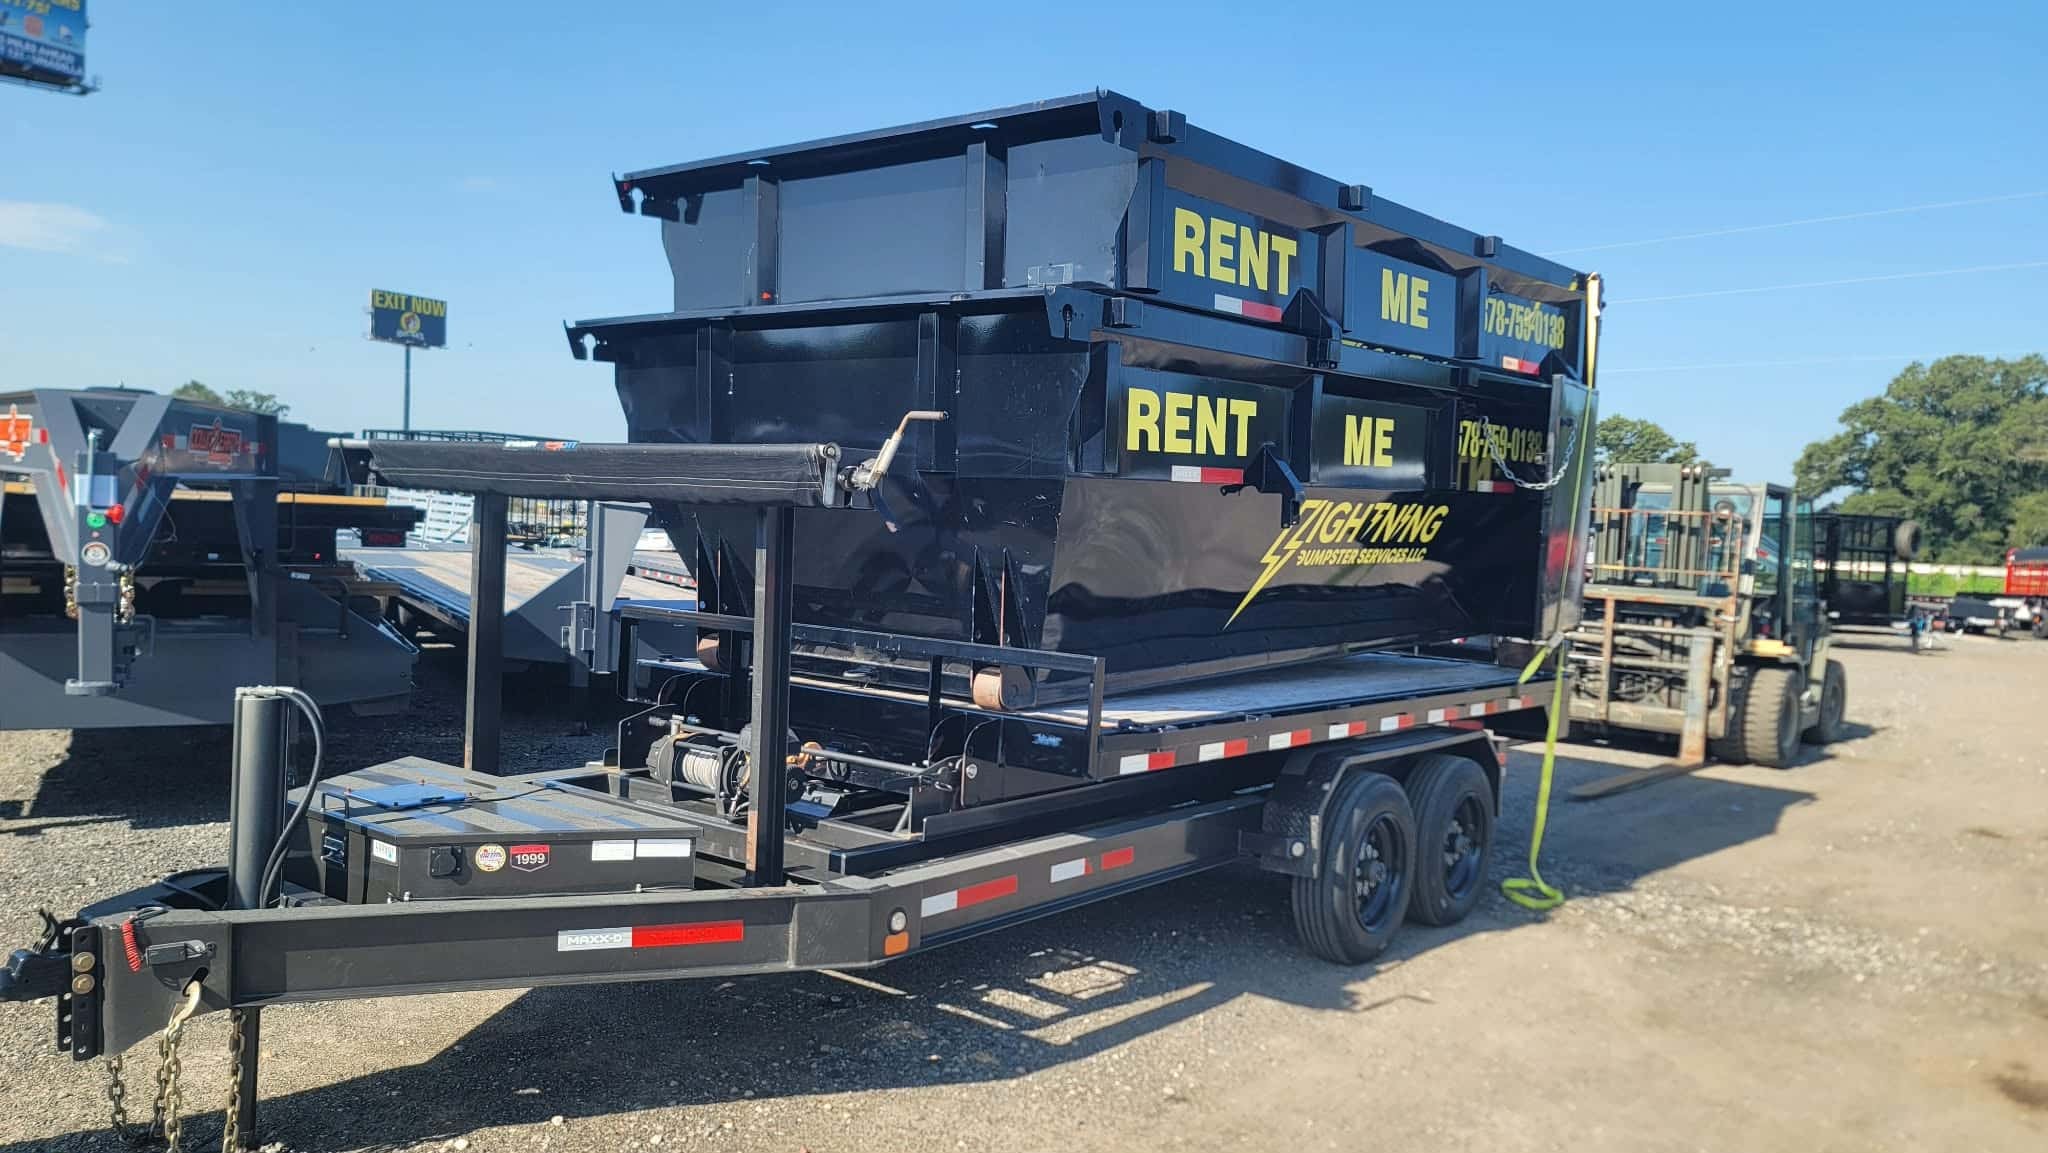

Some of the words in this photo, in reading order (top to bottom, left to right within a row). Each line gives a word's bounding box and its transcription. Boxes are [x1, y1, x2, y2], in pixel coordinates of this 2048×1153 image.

[1173, 207, 1297, 296] RENT
[1381, 268, 1429, 329] ME
[374, 290, 407, 311] EXIT
[411, 296, 446, 317] NOW
[1126, 387, 1257, 457] RENT
[1343, 414, 1395, 468] ME
[1296, 548, 1357, 567] DUMPSTER
[1356, 549, 1407, 565] SERVICES
[1406, 548, 1428, 563] LLC
[515, 853, 546, 865] 1999
[567, 934, 624, 946] MAXX-D
